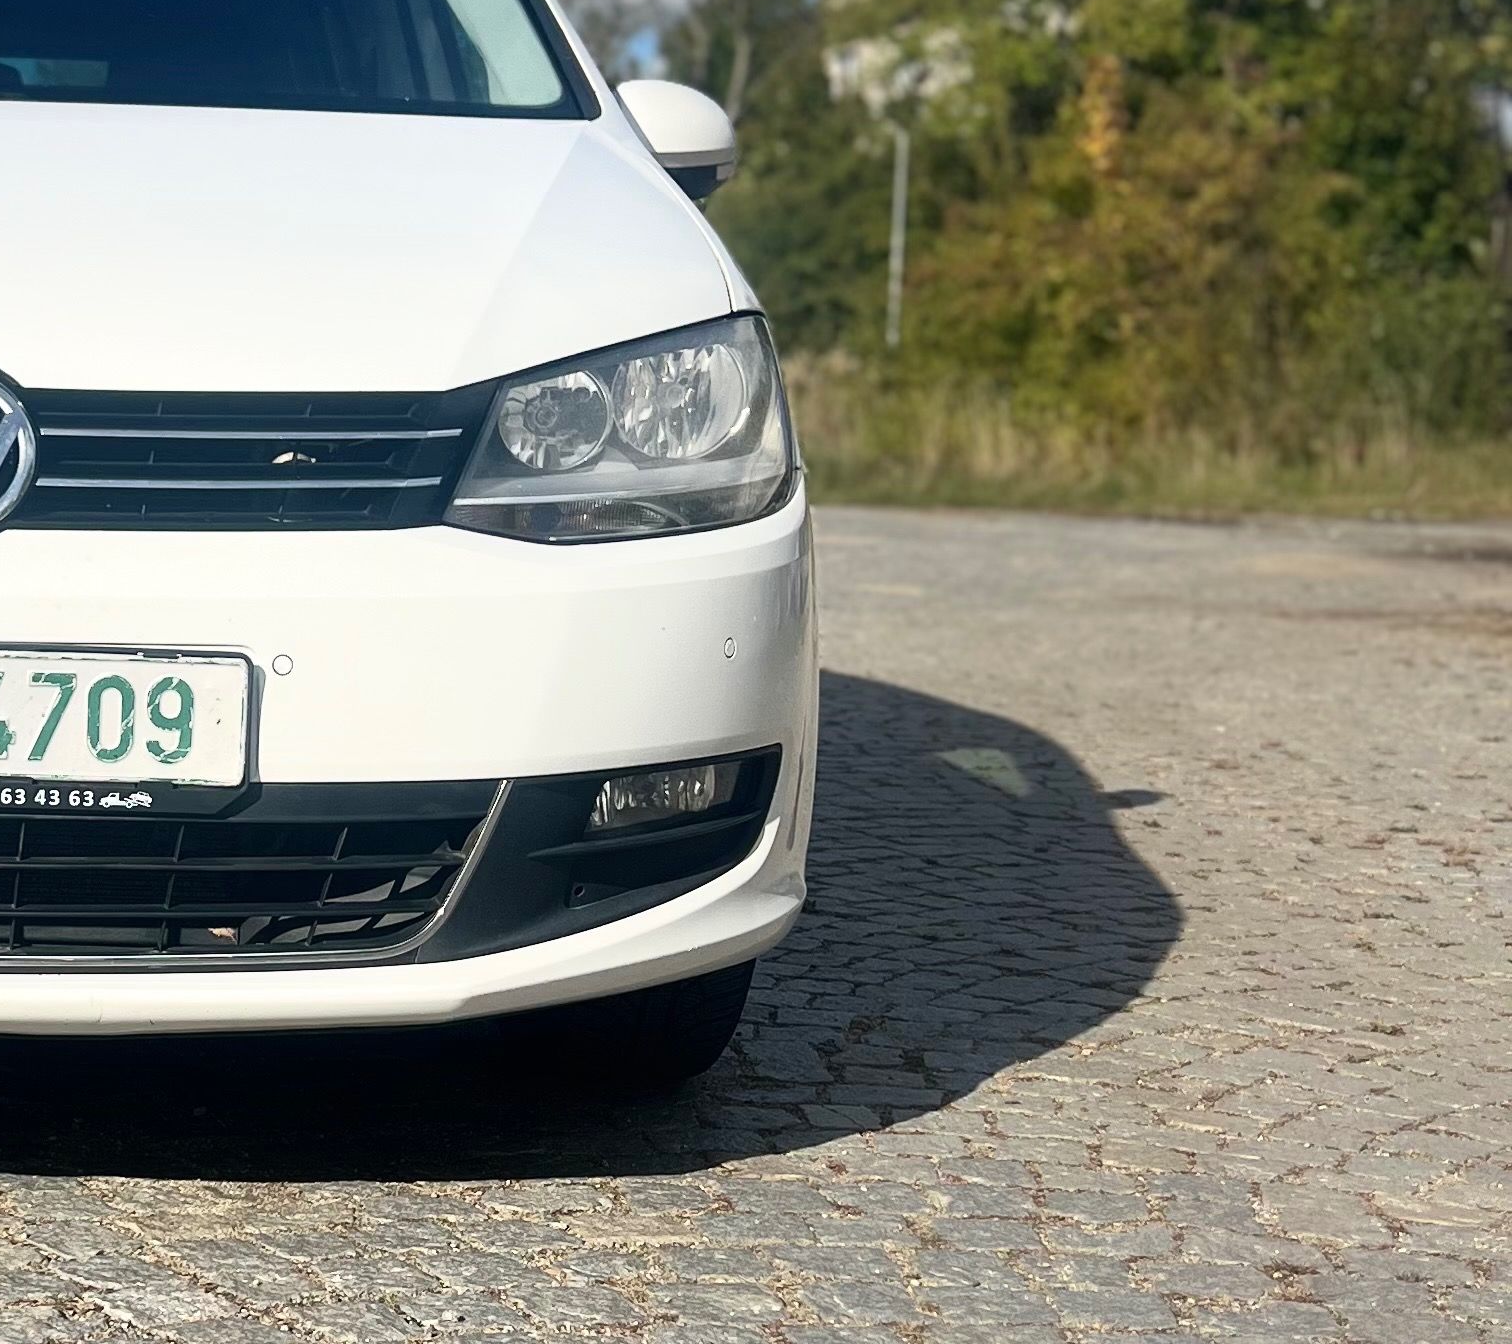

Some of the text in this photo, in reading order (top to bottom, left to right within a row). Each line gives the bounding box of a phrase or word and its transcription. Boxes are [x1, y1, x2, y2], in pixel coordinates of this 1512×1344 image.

[0, 788, 27, 806] 63
[34, 789, 61, 807] 43
[68, 790, 95, 808] 63
